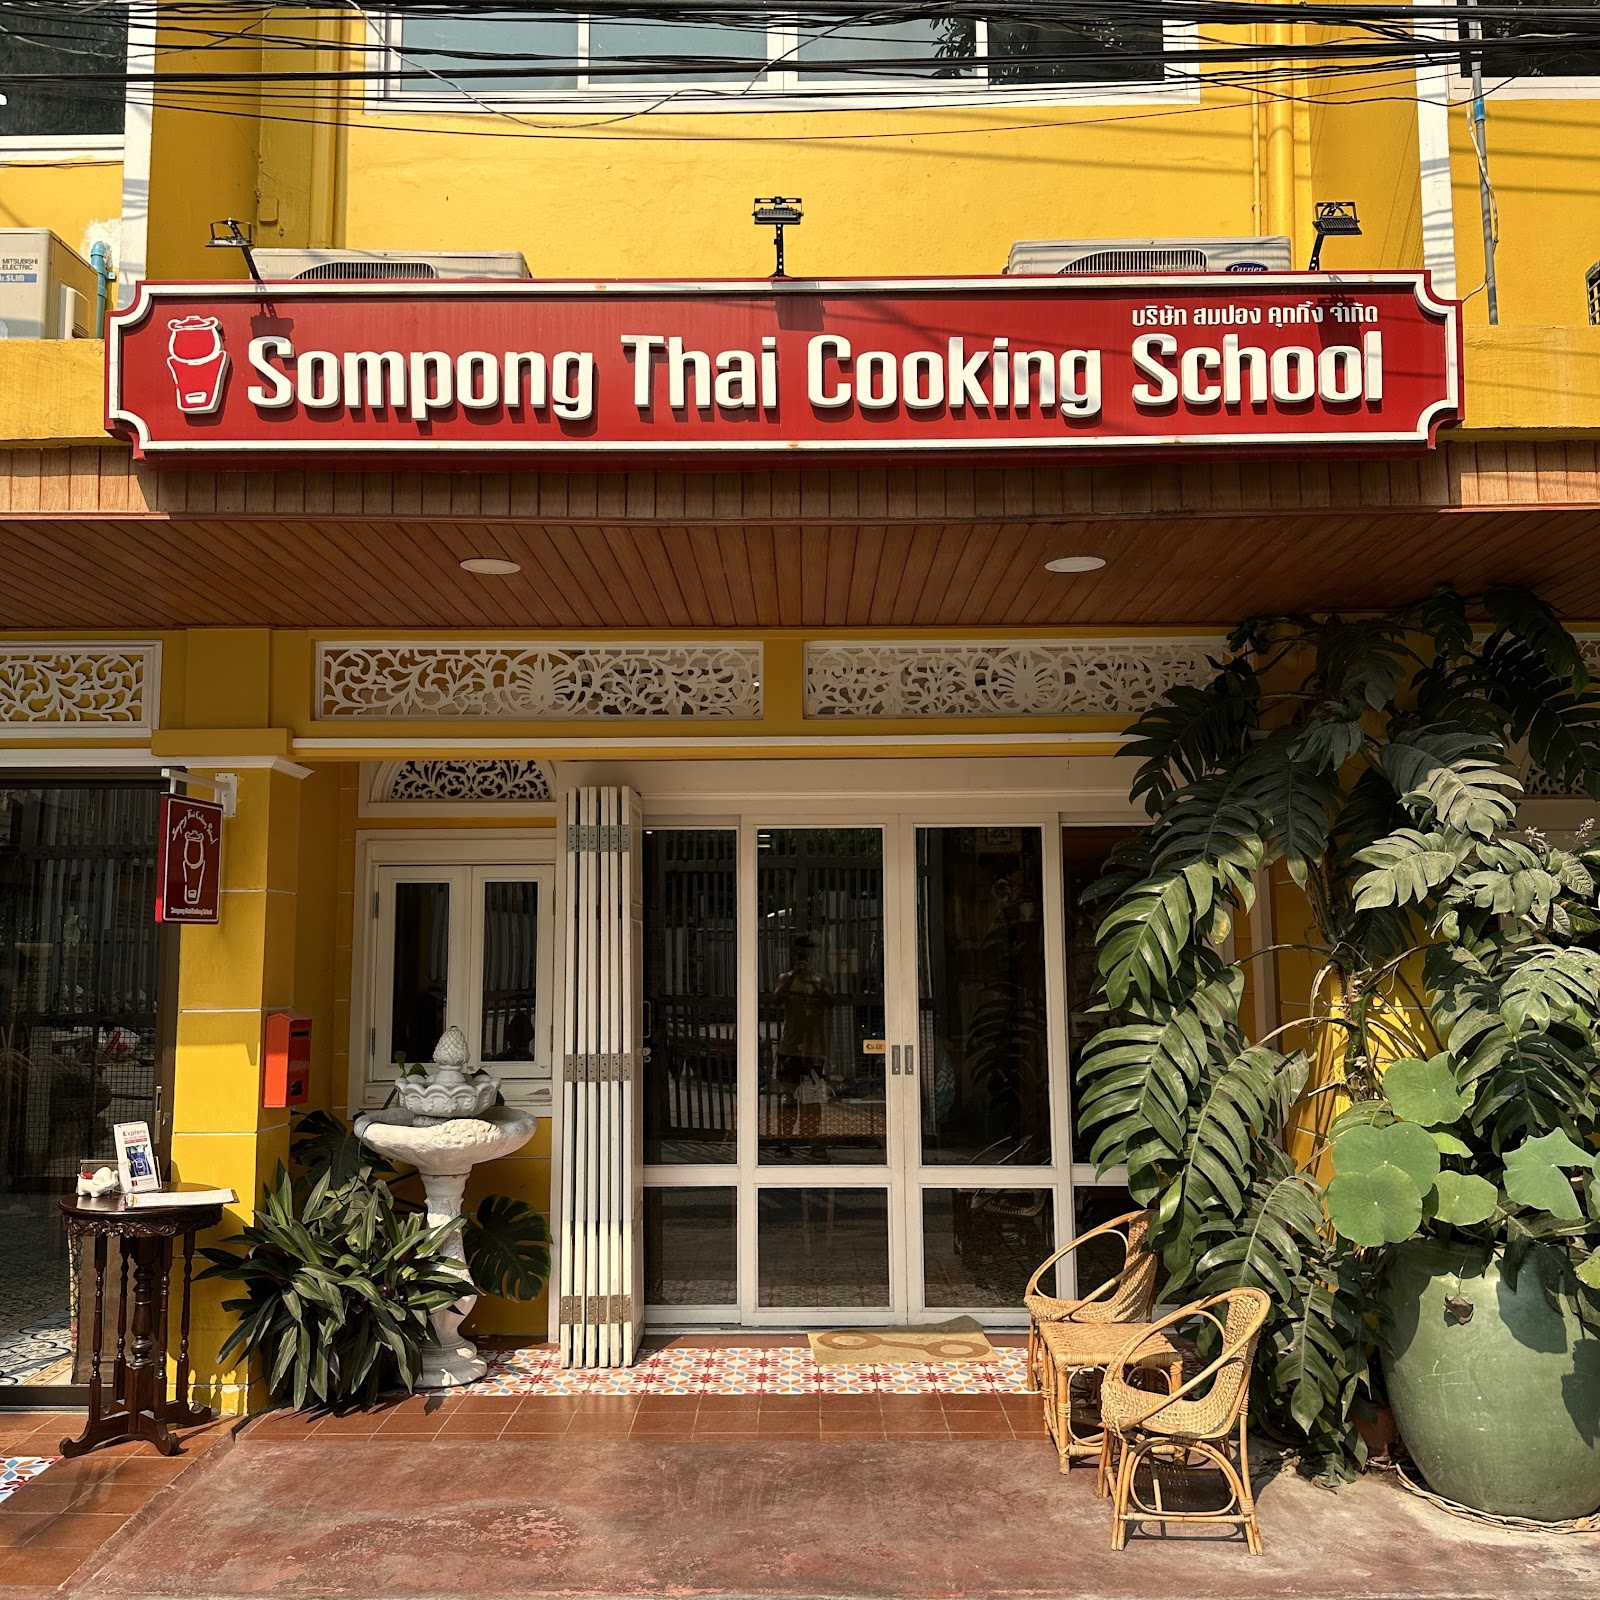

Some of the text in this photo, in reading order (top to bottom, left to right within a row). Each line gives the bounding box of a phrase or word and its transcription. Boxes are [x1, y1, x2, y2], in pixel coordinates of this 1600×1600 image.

[0, 274, 25, 282] r.SLIM
[1132, 300, 1379, 328] บริษัท สมปอง คุกกิ้ง จำกัด
[247, 330, 1383, 421] Sompong Thai Cooking School
